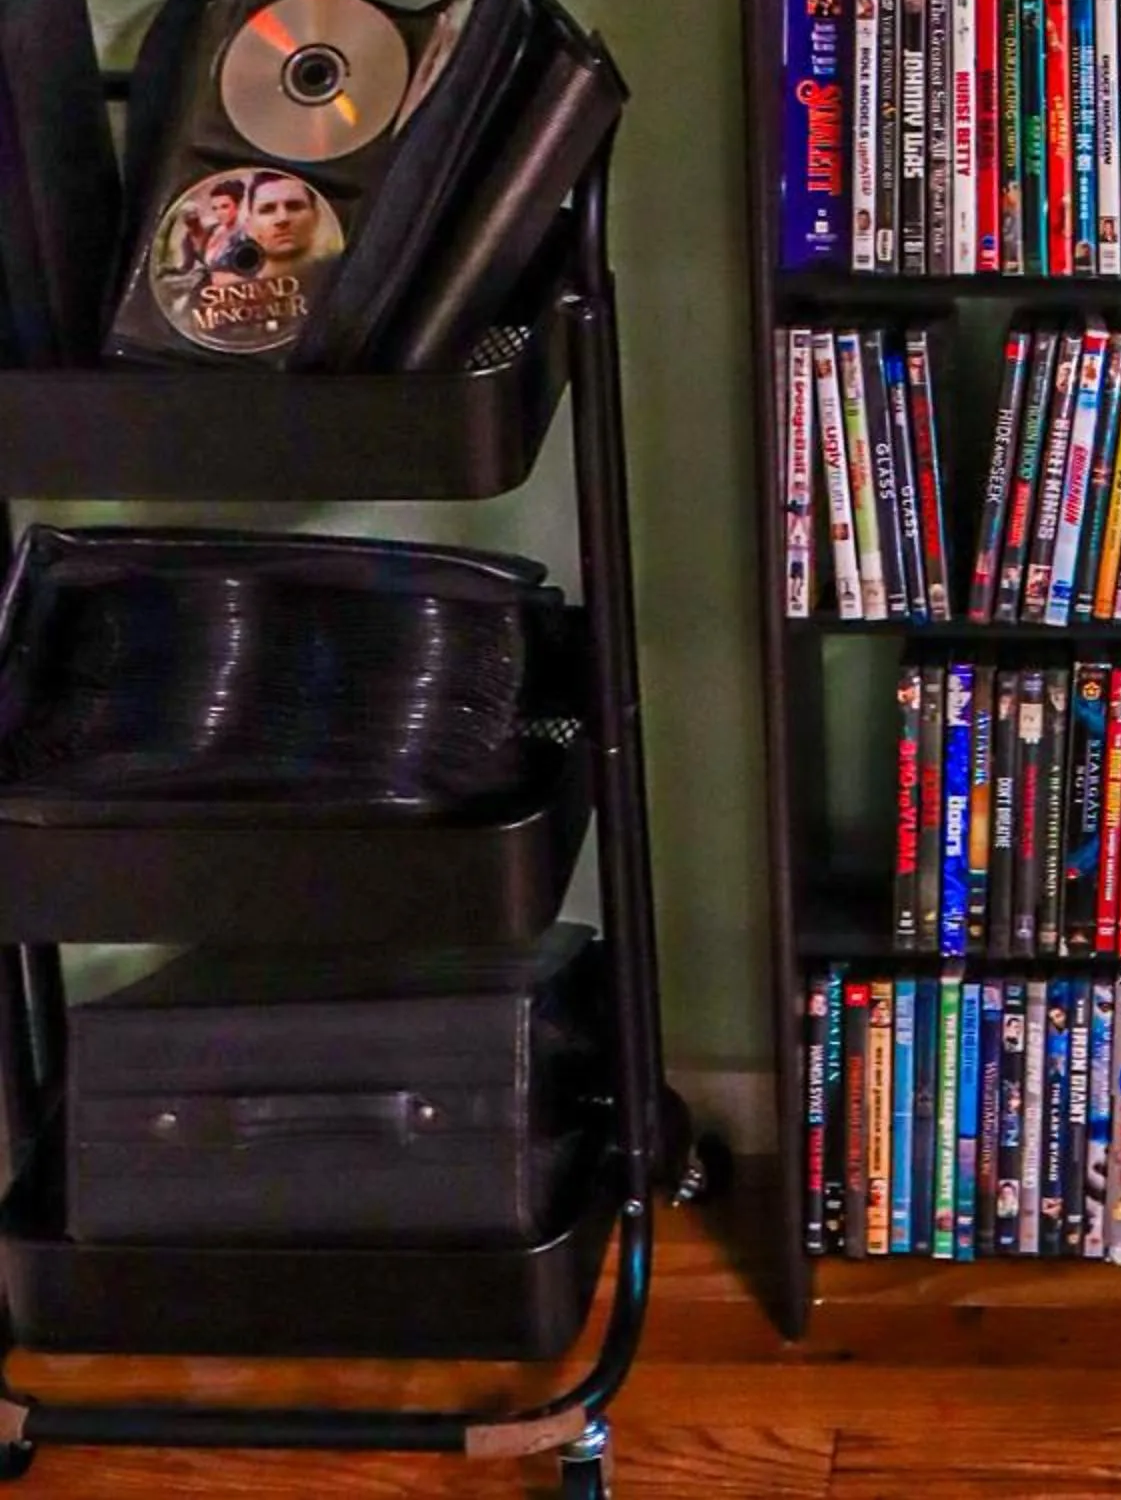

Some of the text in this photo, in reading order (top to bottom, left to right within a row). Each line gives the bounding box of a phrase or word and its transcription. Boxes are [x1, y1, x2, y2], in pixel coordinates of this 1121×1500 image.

[931, 29, 946, 85] Greatest
[859, 47, 870, 139] ROLE MODELS
[903, 48, 923, 179] JOHNNY WAS
[931, 91, 945, 113] Sin
[956, 71, 970, 177] NURSE BETTY
[932, 138, 947, 158] All
[826, 425, 843, 469] ugly
[875, 443, 892, 499] GLASS
[987, 408, 1013, 503] HIDE SEEK
[900, 485, 916, 539] GLASS
[1038, 479, 1062, 541] KINGS
[1084, 739, 1101, 832] STARGATE
[898, 807, 917, 874] YUMA
[827, 973, 842, 1082] ANIMATRIX
[809, 1086, 823, 1124] SYKES
[1070, 1027, 1086, 1125] IRON GIANT
[1049, 1083, 1060, 1182] THE LAST STAND
